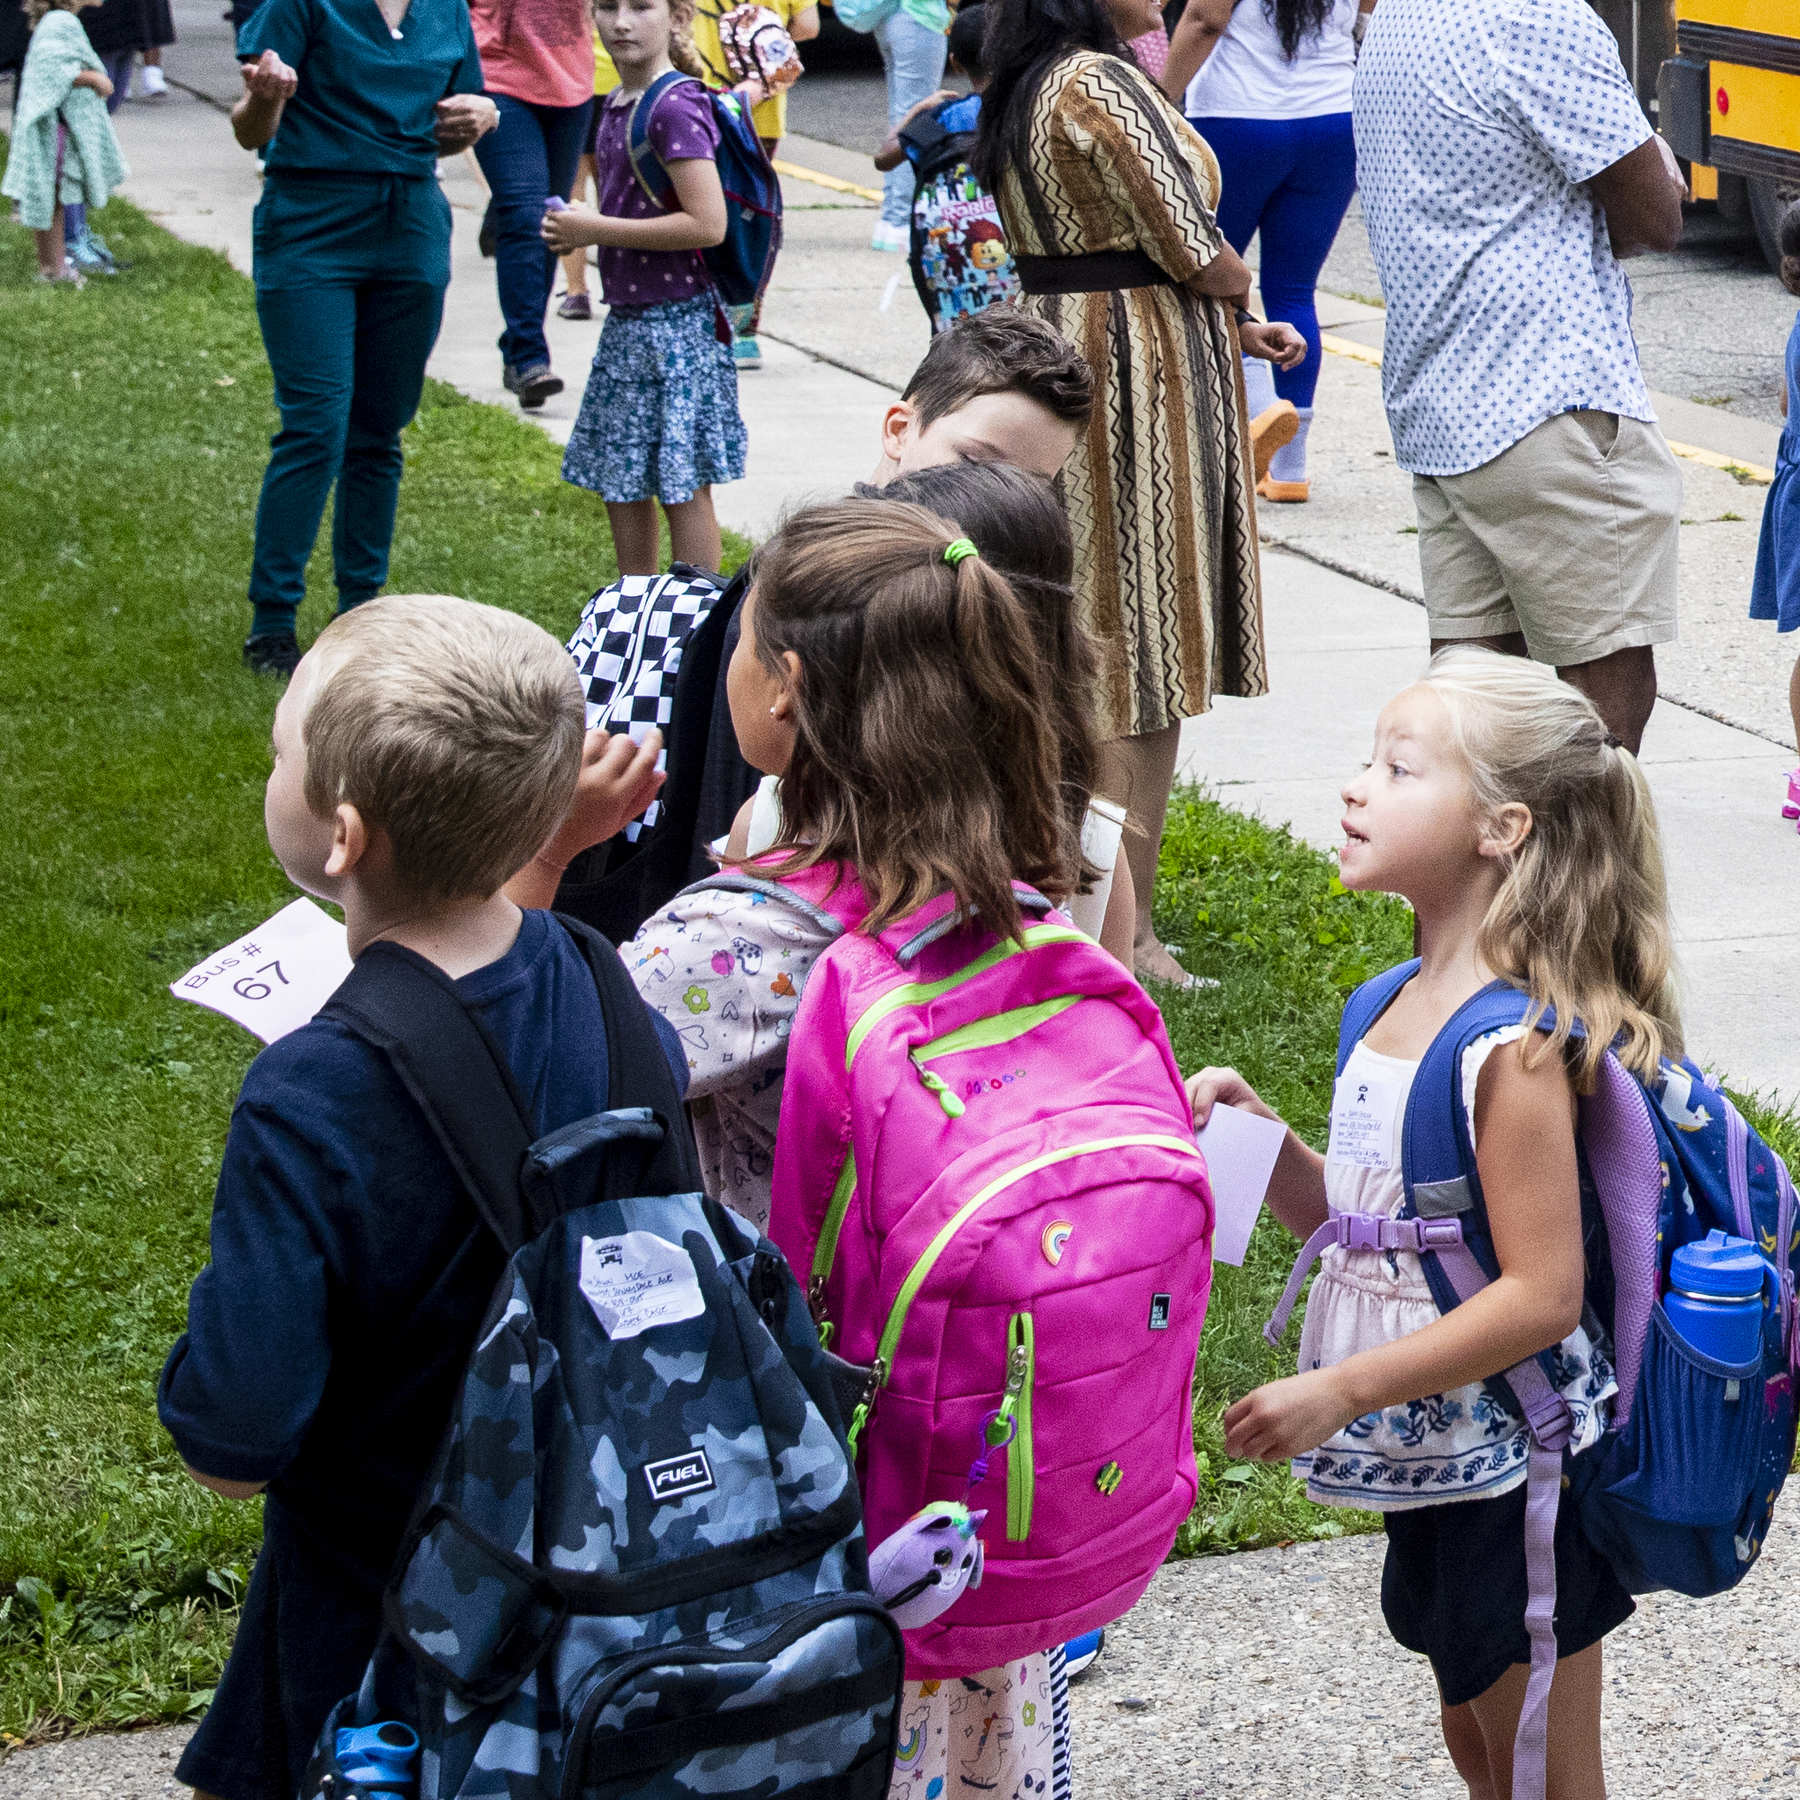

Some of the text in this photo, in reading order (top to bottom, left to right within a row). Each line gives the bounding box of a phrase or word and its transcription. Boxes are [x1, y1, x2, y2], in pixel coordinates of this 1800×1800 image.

[941, 195, 997, 221] ROBLO
[184, 942, 262, 989] Bus #
[233, 960, 290, 1000] 67
[656, 1464, 704, 1487] FUEL
